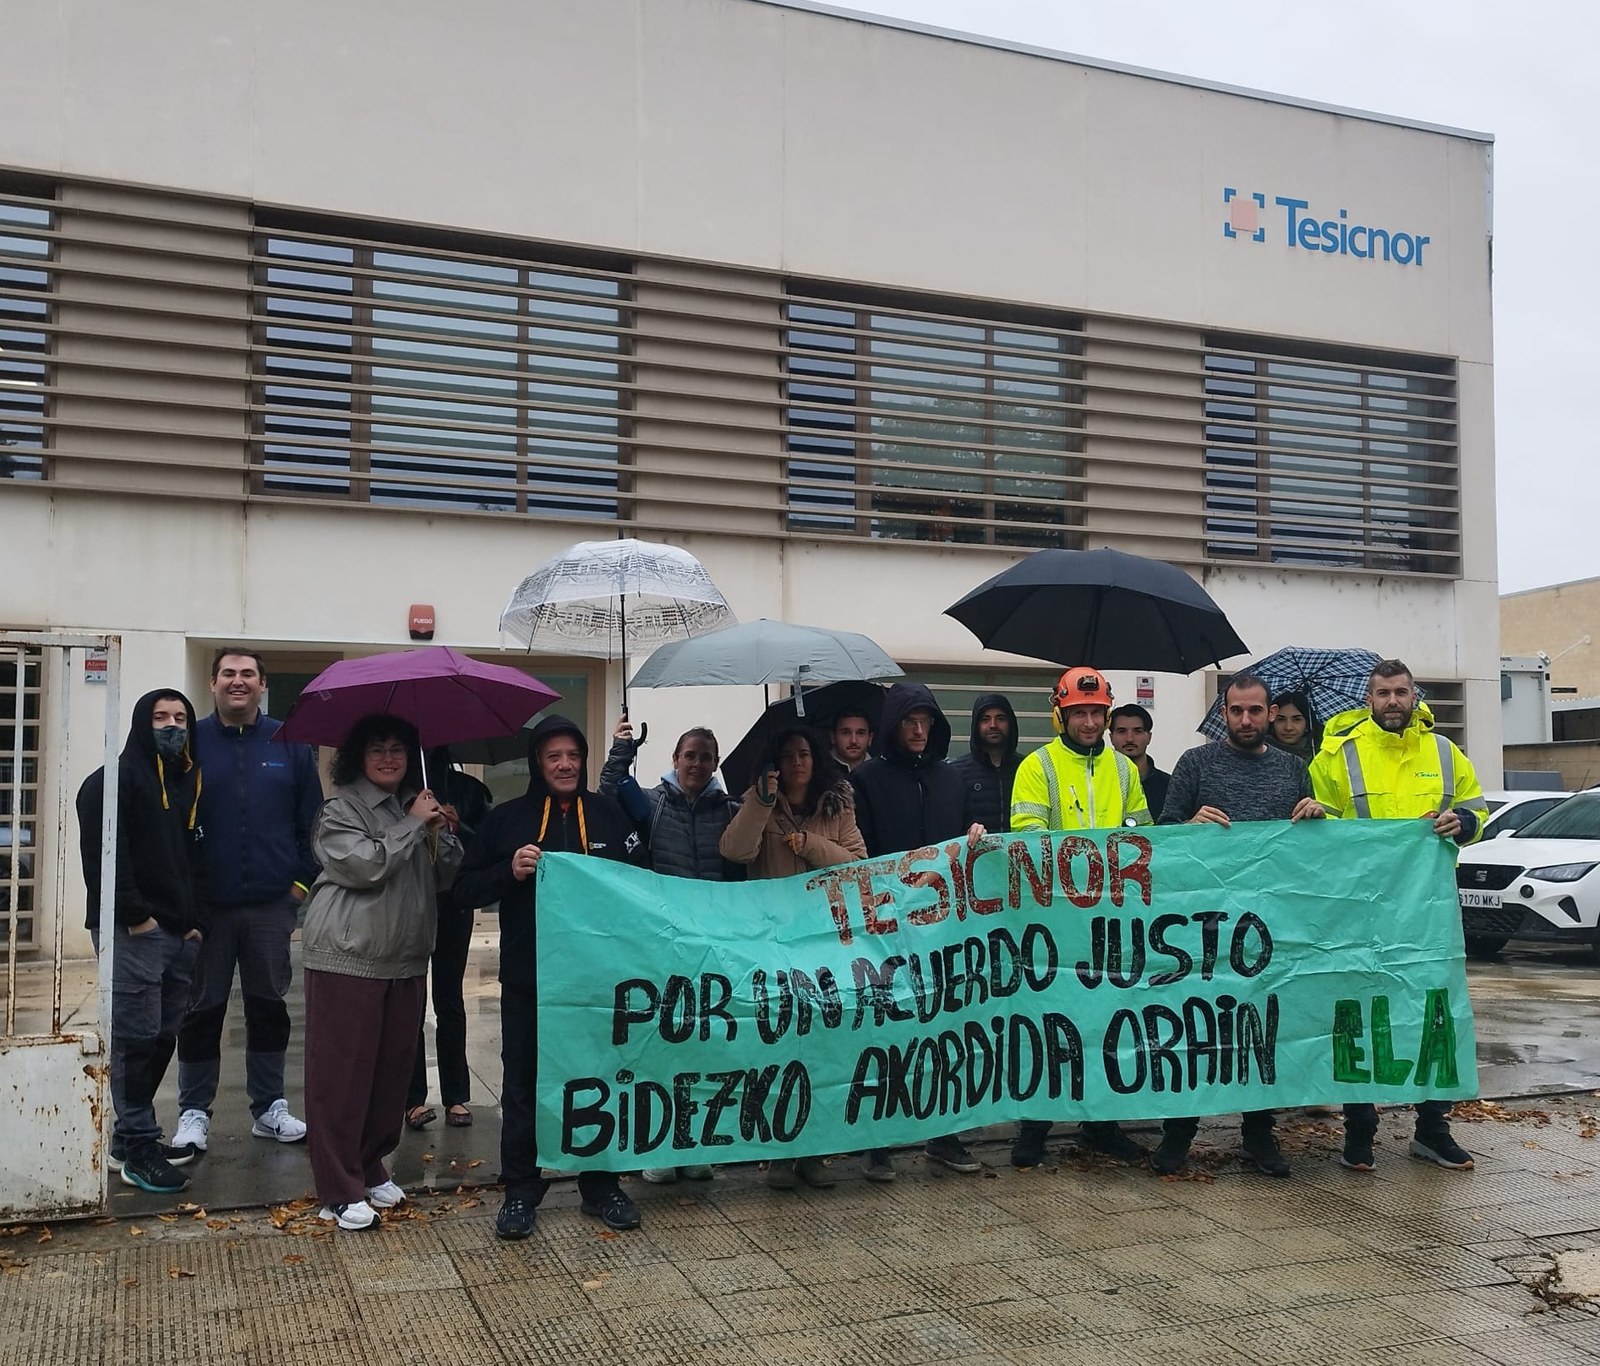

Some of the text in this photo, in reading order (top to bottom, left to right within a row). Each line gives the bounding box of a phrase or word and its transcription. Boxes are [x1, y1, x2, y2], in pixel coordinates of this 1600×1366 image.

[1275, 196, 1430, 266] Tesicnor
[806, 830, 1153, 945] TESICNOR
[612, 911, 1274, 1045] POR UN ACUERDO JUSTO
[1333, 988, 1460, 1088] ELA
